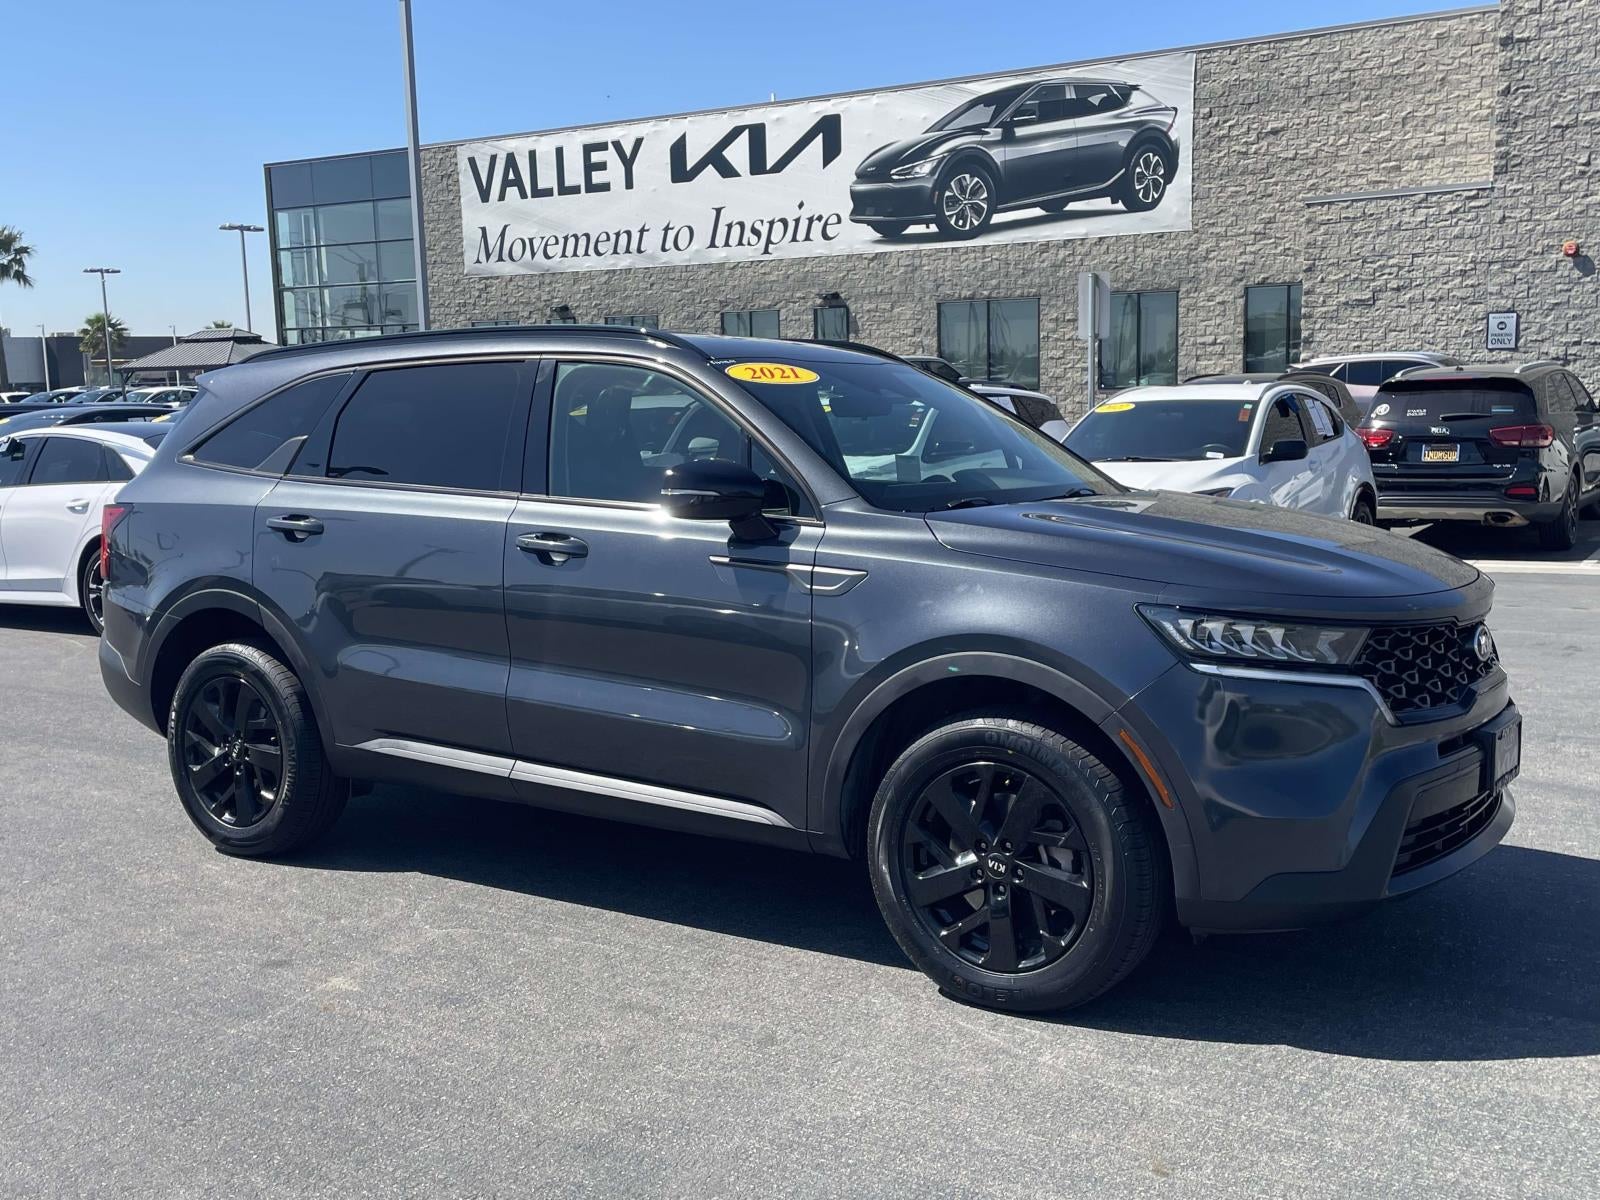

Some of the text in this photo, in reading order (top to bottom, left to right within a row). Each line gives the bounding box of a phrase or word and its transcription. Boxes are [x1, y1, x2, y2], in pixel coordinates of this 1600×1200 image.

[467, 113, 842, 204] VALLEY KIA
[473, 200, 842, 265] Movement to Inspire
[1491, 337, 1513, 345] ONLY
[744, 366, 801, 380] 2021
[987, 858, 1006, 873] KIA
